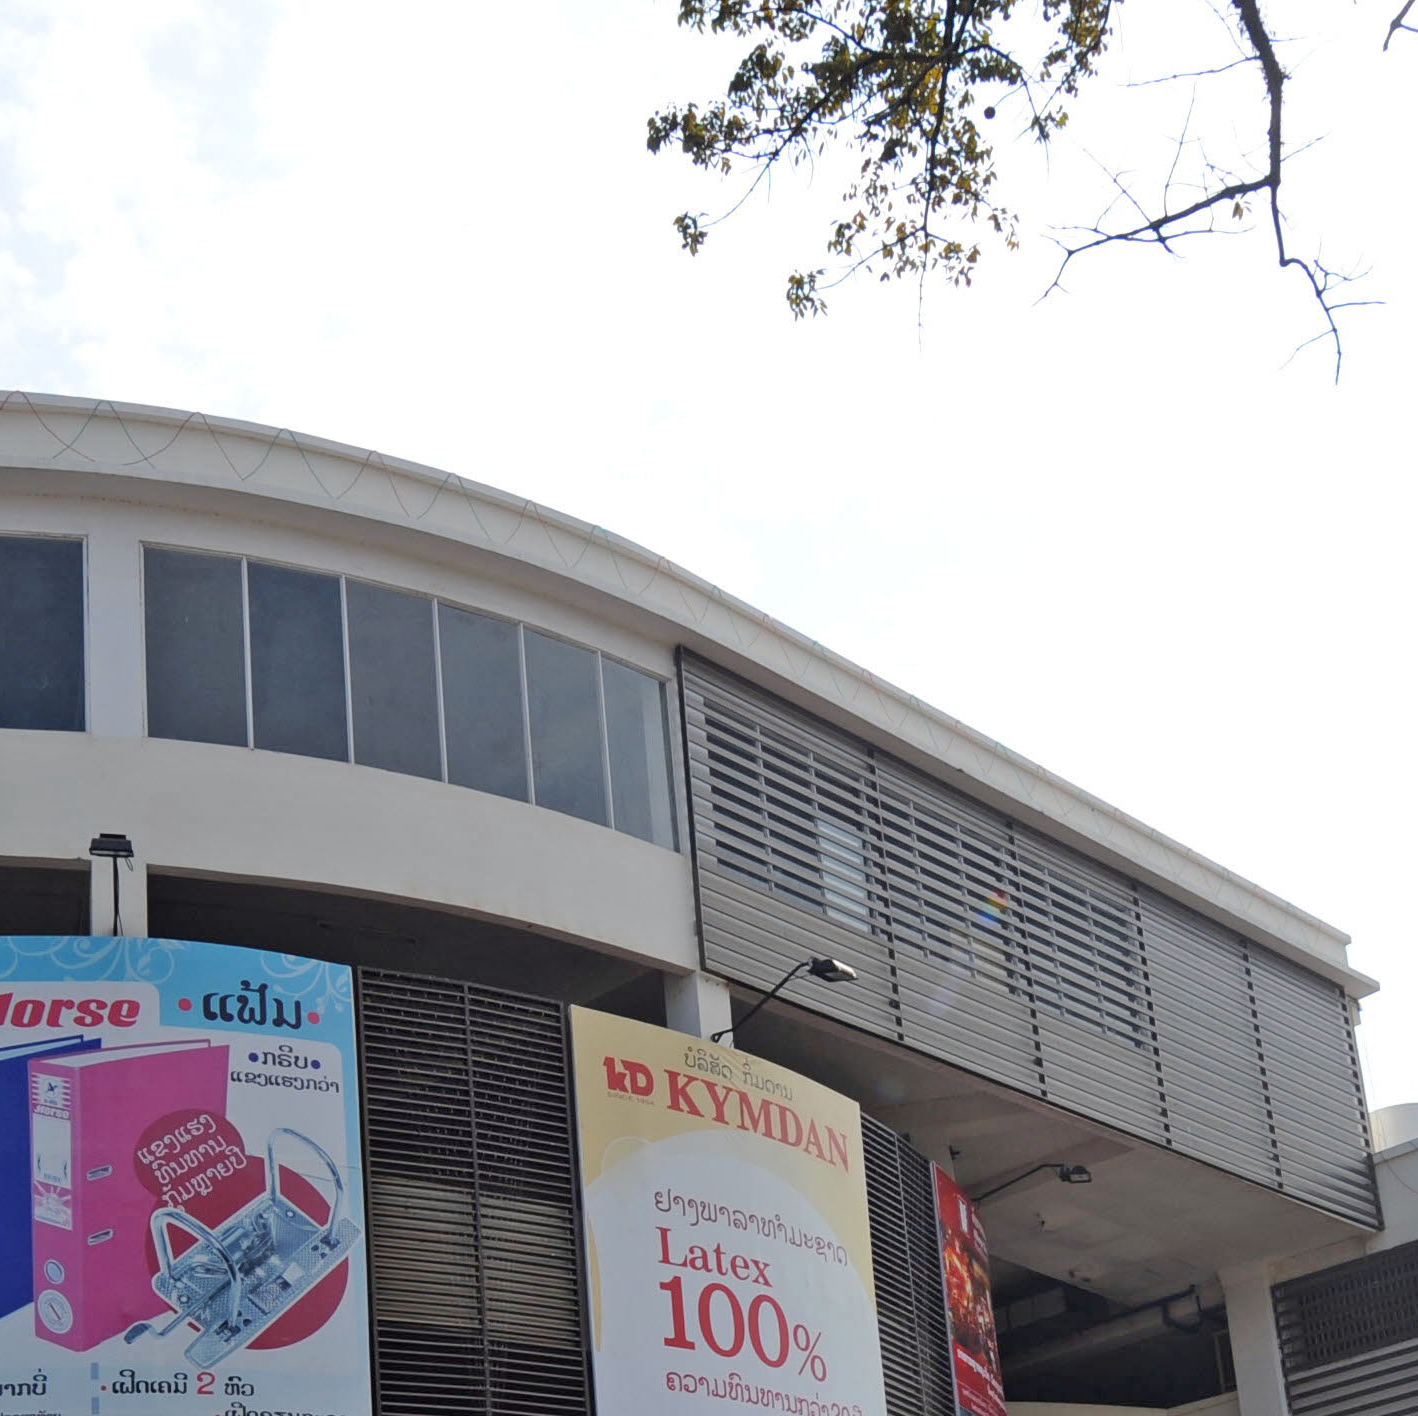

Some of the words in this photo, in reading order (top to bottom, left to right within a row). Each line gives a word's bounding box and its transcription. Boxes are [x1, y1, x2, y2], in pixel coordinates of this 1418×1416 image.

[201, 979, 303, 1030] ແຟ້ມ
[684, 1046, 733, 1081] ບໍລິສັດ
[34, 1104, 70, 1119] Horse
[663, 1068, 851, 1174] KYMDAN
[137, 1114, 218, 1165] ແຂງແຮງ
[655, 1225, 773, 1289] Latex
[658, 1275, 829, 1383] 100%
[196, 1371, 215, 1395] 2
[224, 1374, 255, 1397] ຫົວ
